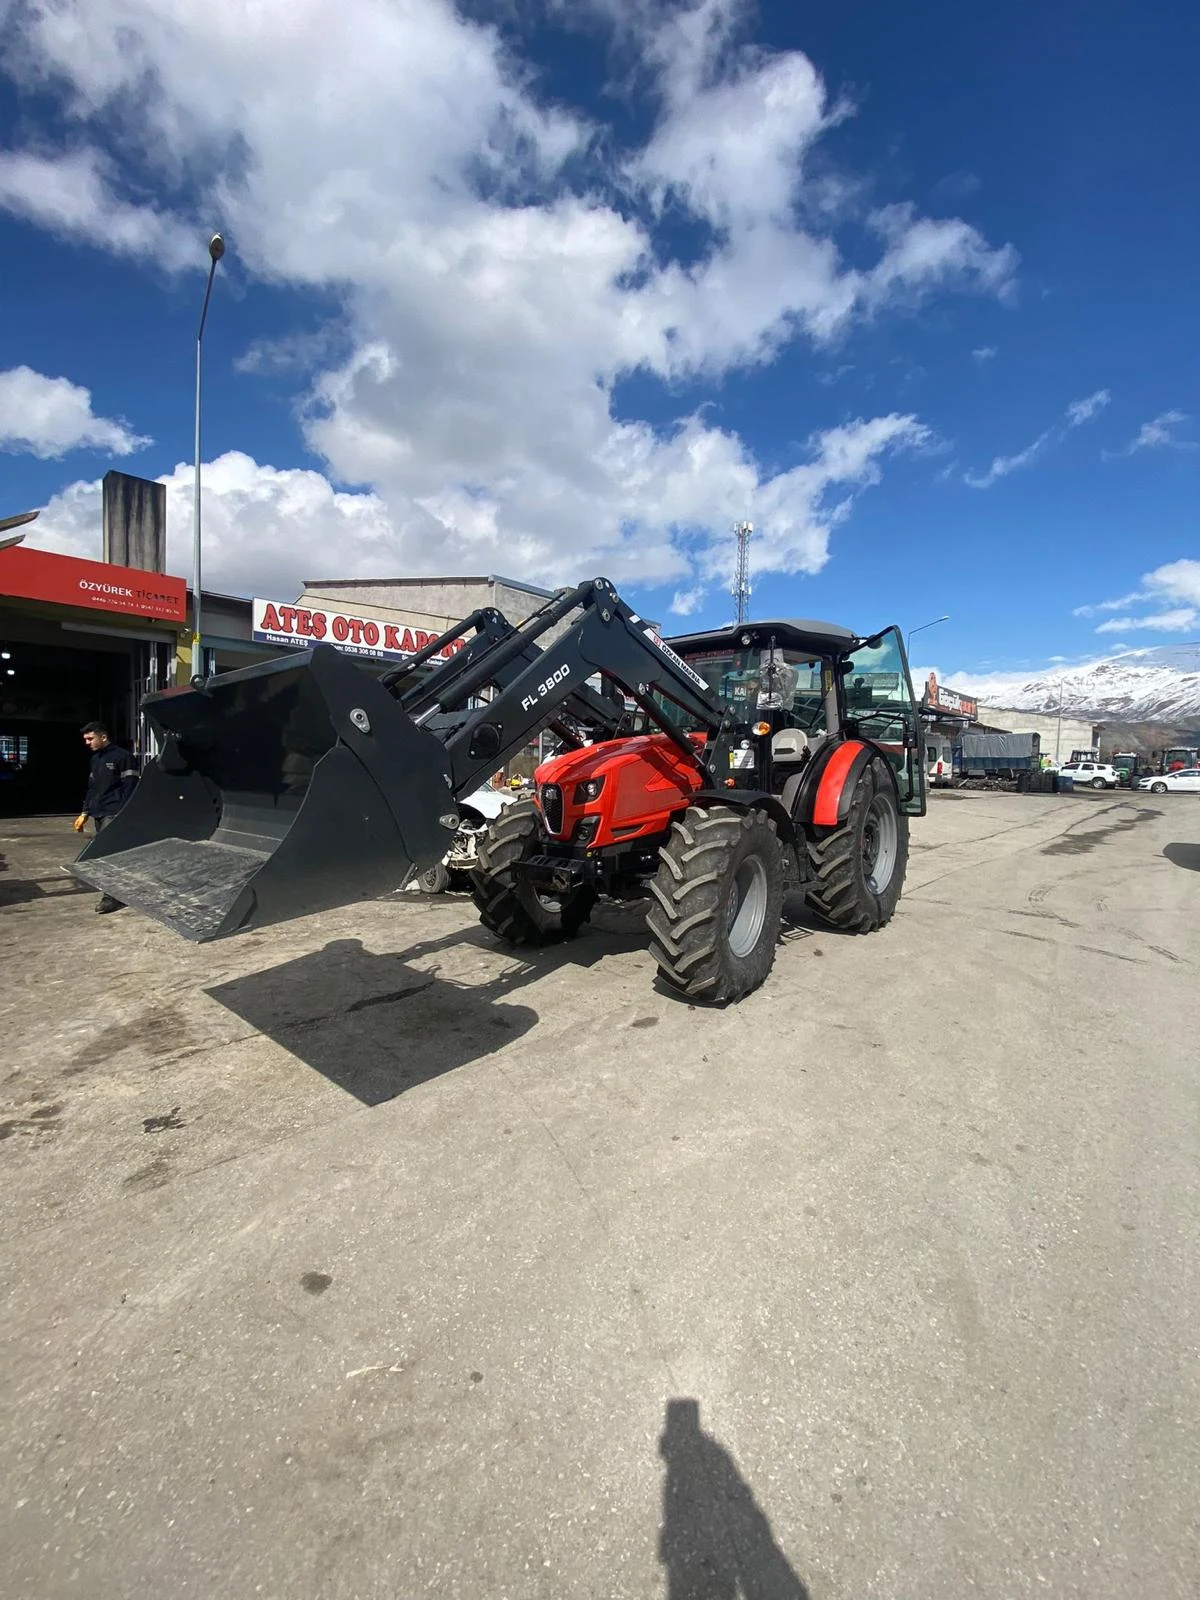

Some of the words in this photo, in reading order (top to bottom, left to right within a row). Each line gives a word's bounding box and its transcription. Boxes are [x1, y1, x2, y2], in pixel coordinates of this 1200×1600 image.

[79, 579, 133, 597] ÖZYÜREK
[261, 603, 327, 640] ATEŞ
[332, 616, 379, 647] OTO
[266, 634, 289, 643] Hasan
[521, 694, 538, 711] FL
[537, 663, 571, 697] 3800
